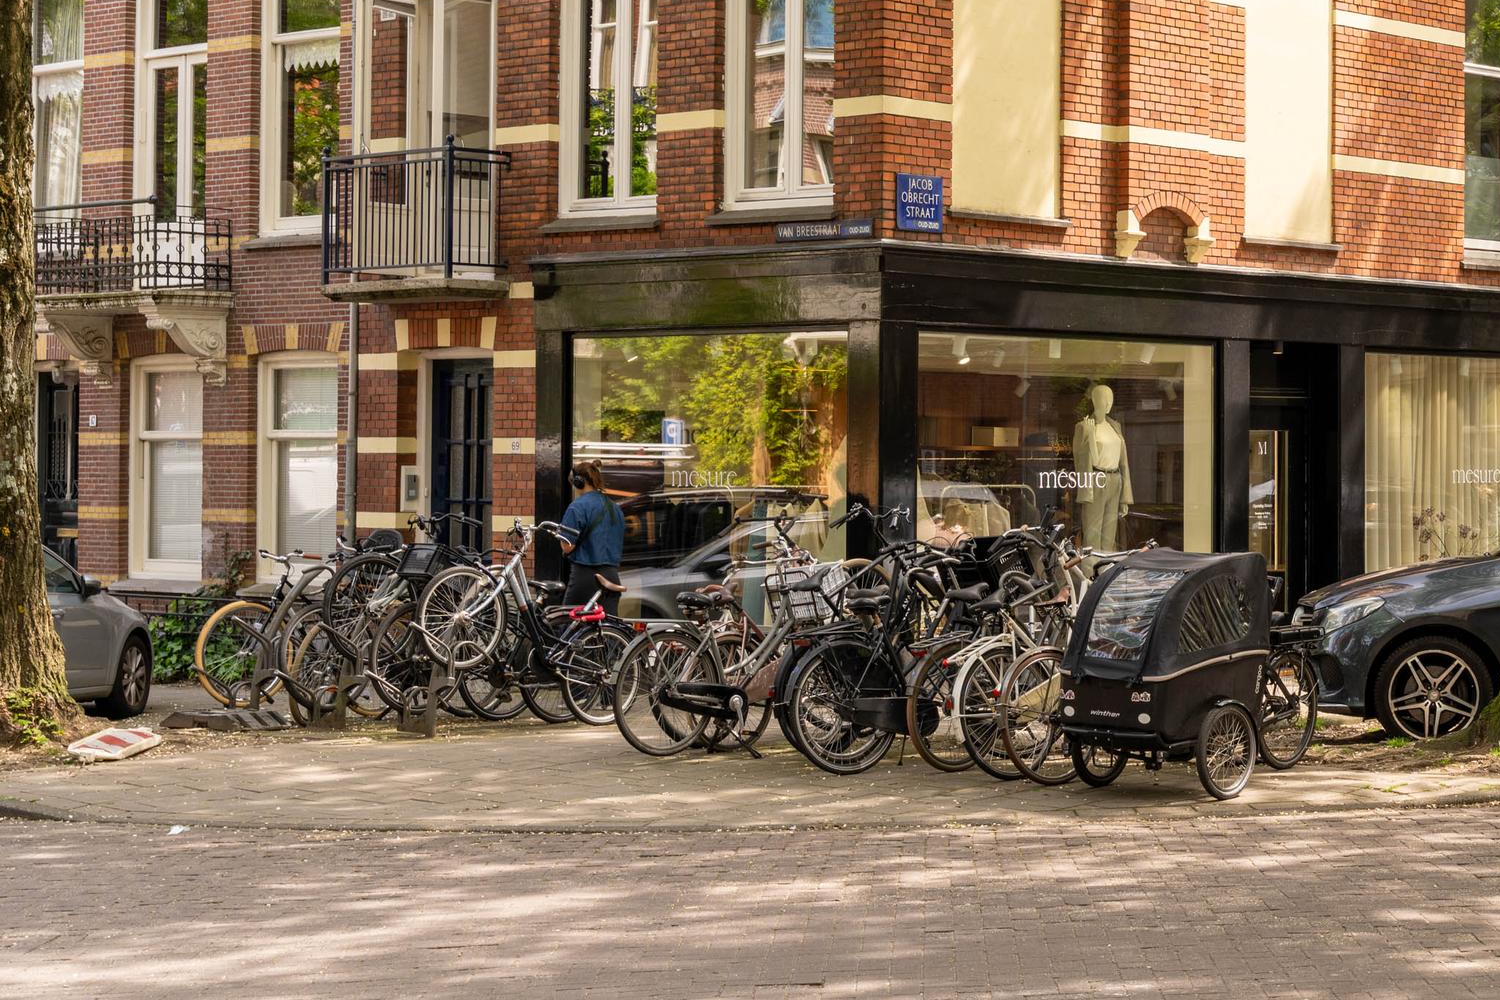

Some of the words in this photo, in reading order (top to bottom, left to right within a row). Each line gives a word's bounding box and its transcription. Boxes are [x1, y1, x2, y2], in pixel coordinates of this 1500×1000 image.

[908, 178, 933, 191] JACOB
[901, 191, 940, 206] OBRECHT
[905, 206, 936, 219] STRAAT
[778, 226, 793, 238] VAN
[796, 224, 842, 237] BREESTRAAT
[511, 441, 520, 451] 69
[671, 470, 738, 488] mesure
[1090, 709, 1121, 718] winther
